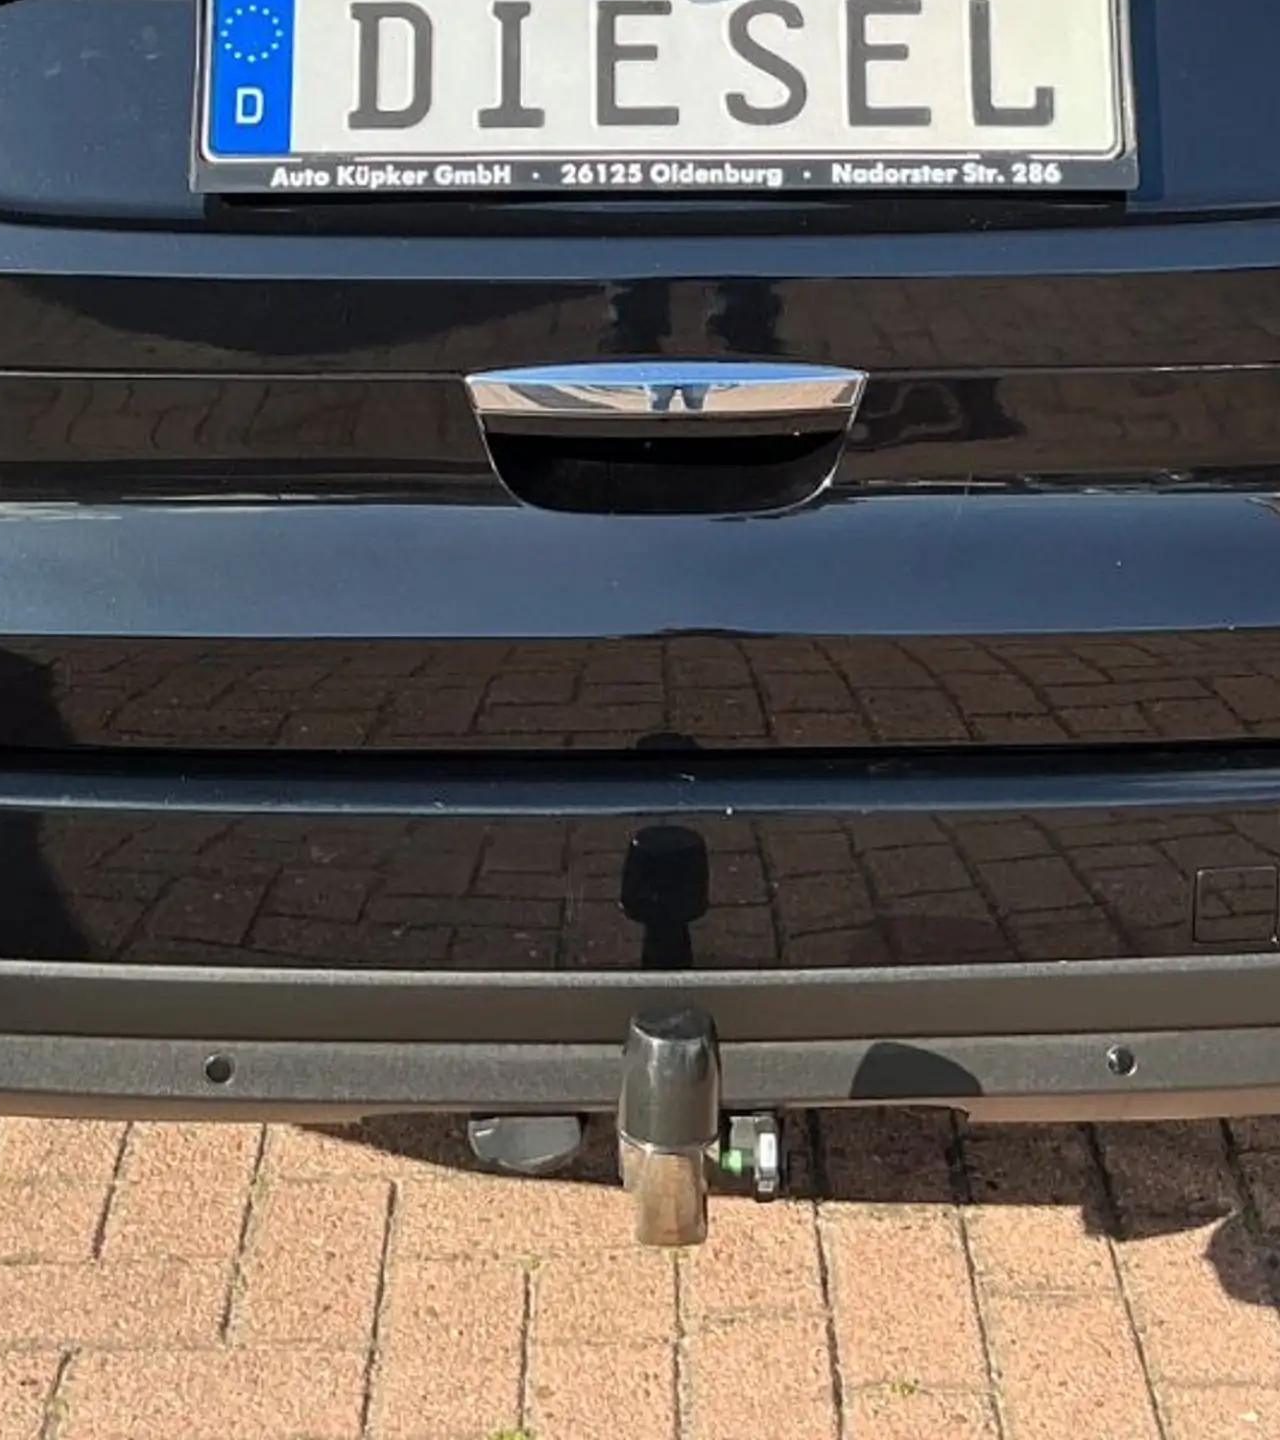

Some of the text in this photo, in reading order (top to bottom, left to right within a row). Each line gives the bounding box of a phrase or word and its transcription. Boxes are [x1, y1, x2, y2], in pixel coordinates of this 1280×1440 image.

[235, 88, 264, 124] D
[270, 163, 1062, 189] Auto Küpker GmbH 26125 Oldenburg Nadorster Str. 286
